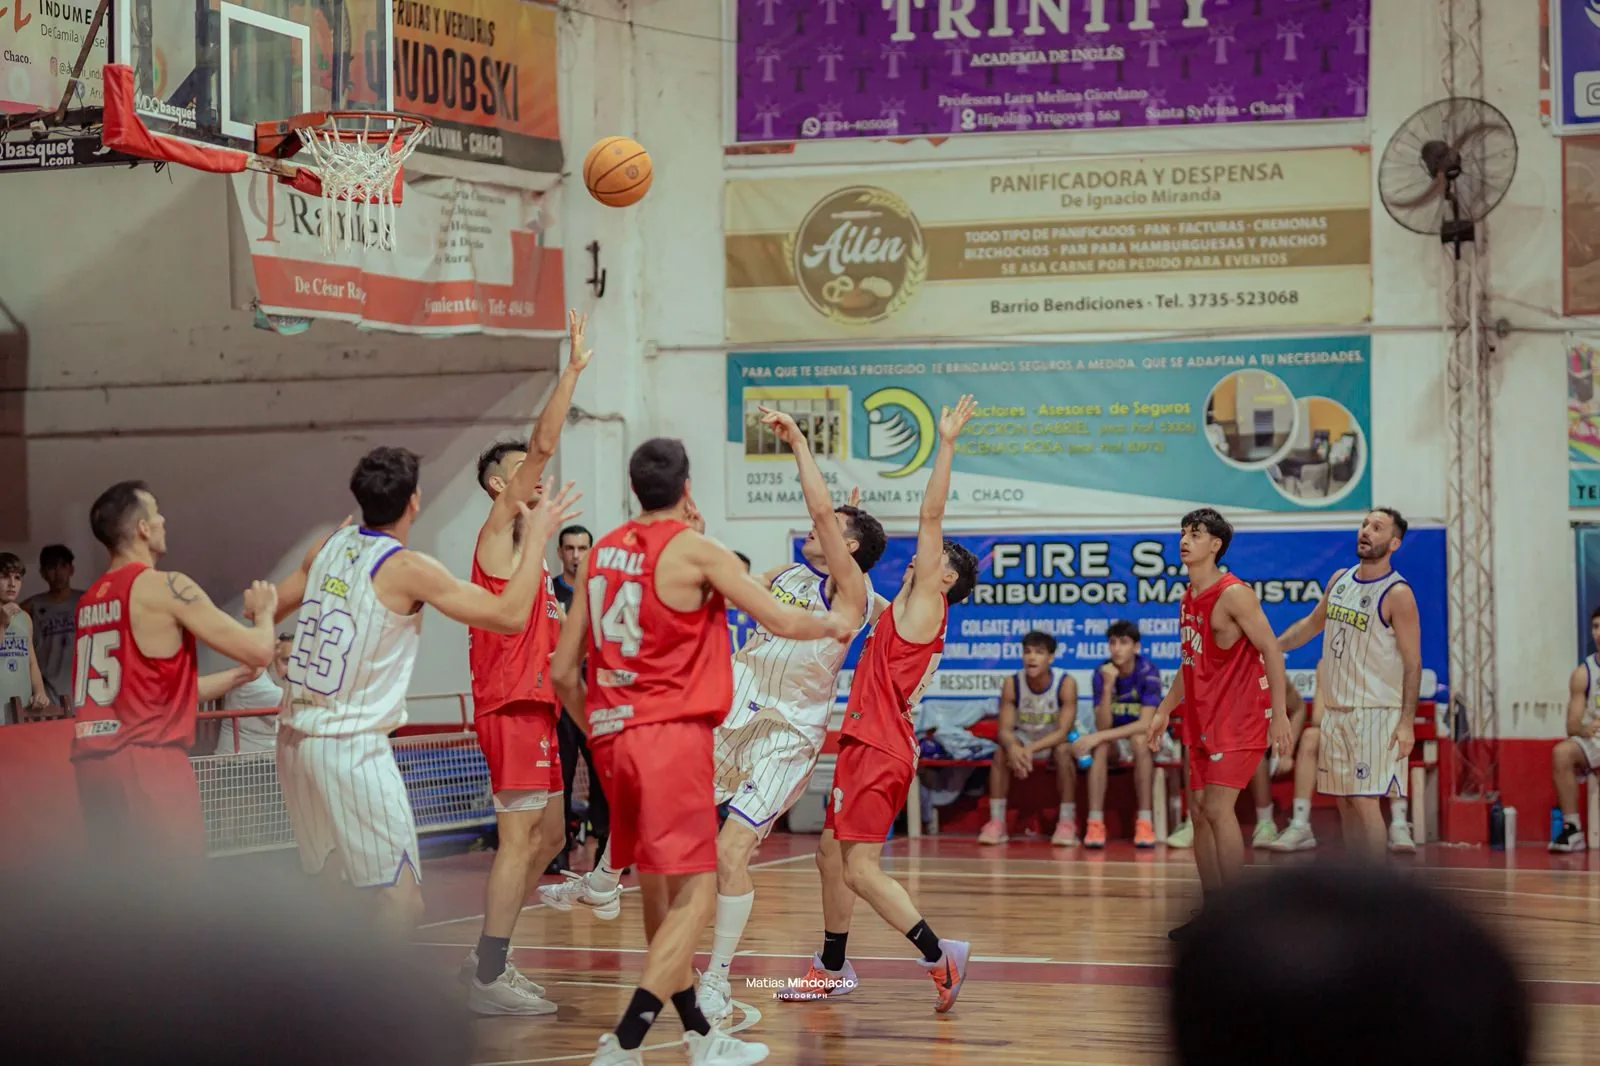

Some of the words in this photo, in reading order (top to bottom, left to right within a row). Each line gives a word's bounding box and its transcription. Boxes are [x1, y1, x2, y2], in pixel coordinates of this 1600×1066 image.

[882, 0, 1208, 42] TRINITY
[4, 49, 32, 65] Chaco.
[970, 51, 1045, 67] ACADEMIA
[1049, 50, 1069, 64] DE
[938, 92, 1001, 107] Profesora
[1084, 86, 1148, 101] Giordano
[1145, 105, 1184, 120] Santa
[1250, 99, 1294, 115] Chaco
[990, 169, 1148, 193] PANIFICADORA
[1152, 167, 1166, 186] Y
[1171, 162, 1285, 186] DESPENSA
[1060, 193, 1083, 208] De
[1087, 190, 1148, 210] Ignacio
[1151, 186, 1222, 204] Miranda
[965, 230, 999, 243] TODO
[1002, 229, 1030, 242] TIPO
[1033, 228, 1049, 240] DE
[1052, 224, 1136, 239] PANIFICADOS
[1143, 222, 1171, 236] PAN
[1178, 219, 1245, 235] FACTURAS
[1253, 216, 1328, 232] CREMONAS
[803, 220, 908, 276] Ailén
[1060, 243, 1088, 256] PAN
[1091, 242, 1127, 255] PARA
[1130, 236, 1245, 254] HAMBURGUESAS
[1247, 236, 1257, 248] Y
[1259, 233, 1328, 248] PANCHOS
[1001, 262, 1017, 275] SE
[1019, 260, 1047, 274] ASA
[1050, 258, 1095, 273] CARNE
[1098, 257, 1126, 270] POR
[1129, 255, 1181, 270] PEDIDO
[1184, 254, 1222, 268] PARA
[1224, 252, 1288, 267] EVENTOS
[990, 299, 1040, 314] Barrio
[1043, 295, 1144, 312] Bendiciones
[1155, 292, 1184, 308] Tel.
[1188, 289, 1299, 308] 3735-523068
[742, 366, 772, 378] PARA
[774, 365, 798, 379] QUE
[800, 365, 812, 377] TE
[814, 364, 857, 378] SIENTAS
[859, 362, 926, 376] PROTEGIDO
[946, 359, 1015, 373] BRINDAMOS
[1018, 359, 1072, 372] SEGUROS
[1076, 359, 1086, 370] A
[1087, 357, 1136, 370] MEDIDA
[1142, 356, 1167, 369] QUE
[1170, 355, 1184, 368] SE
[1186, 354, 1245, 367] ADAPTAN
[1248, 354, 1258, 366] A
[1260, 353, 1275, 366] TU
[1277, 350, 1364, 365] NECESIDADES.
[1109, 402, 1129, 415] de
[1132, 401, 1190, 417] Seguros
[747, 472, 782, 485] 03735
[747, 490, 772, 503] SAN
[861, 489, 902, 502] SANTA
[972, 487, 1025, 501] CHACO
[596, 546, 645, 576] WALL
[992, 543, 1111, 578] FIRE
[79, 599, 121, 629] ARAUJO
[588, 574, 643, 658] 14
[285, 599, 357, 696] 33
[1331, 627, 1346, 660] 4
[75, 629, 121, 707] 15
